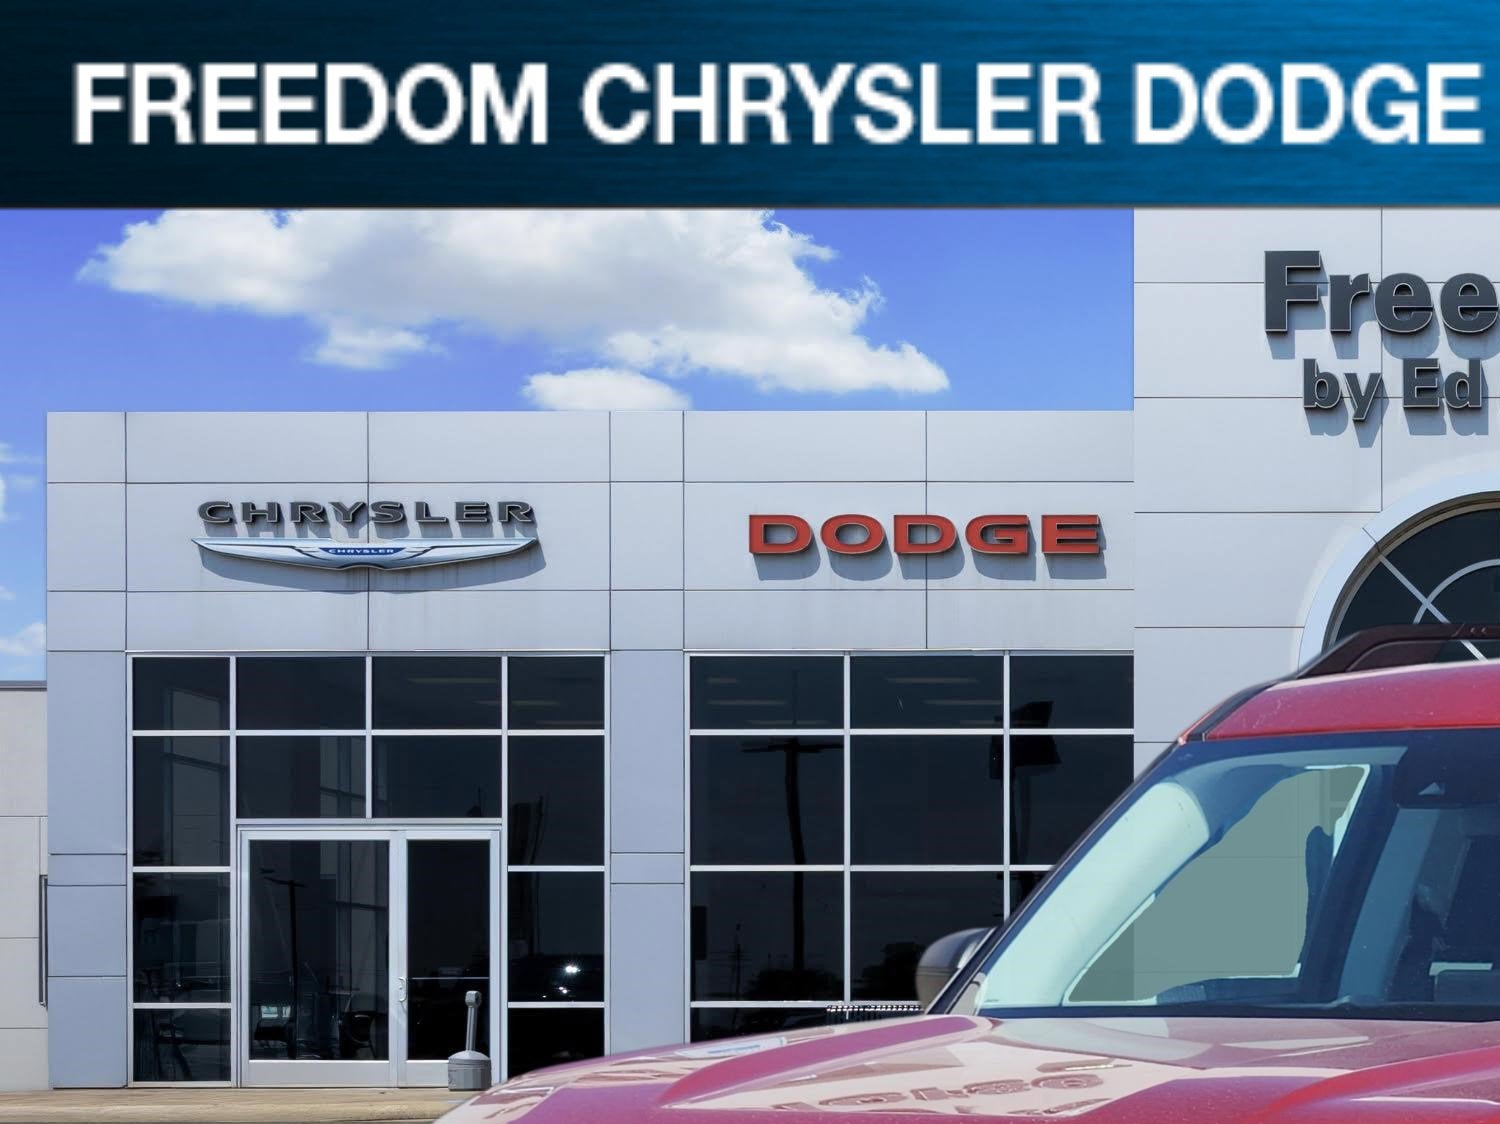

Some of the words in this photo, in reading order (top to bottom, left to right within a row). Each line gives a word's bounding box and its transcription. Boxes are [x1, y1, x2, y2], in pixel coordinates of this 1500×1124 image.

[1303, 358, 1382, 422] by
[1402, 358, 1482, 409] Ed
[197, 500, 534, 524] CHRYSLER
[748, 514, 1100, 554] DODGE
[327, 547, 395, 555] CHRYSLER
